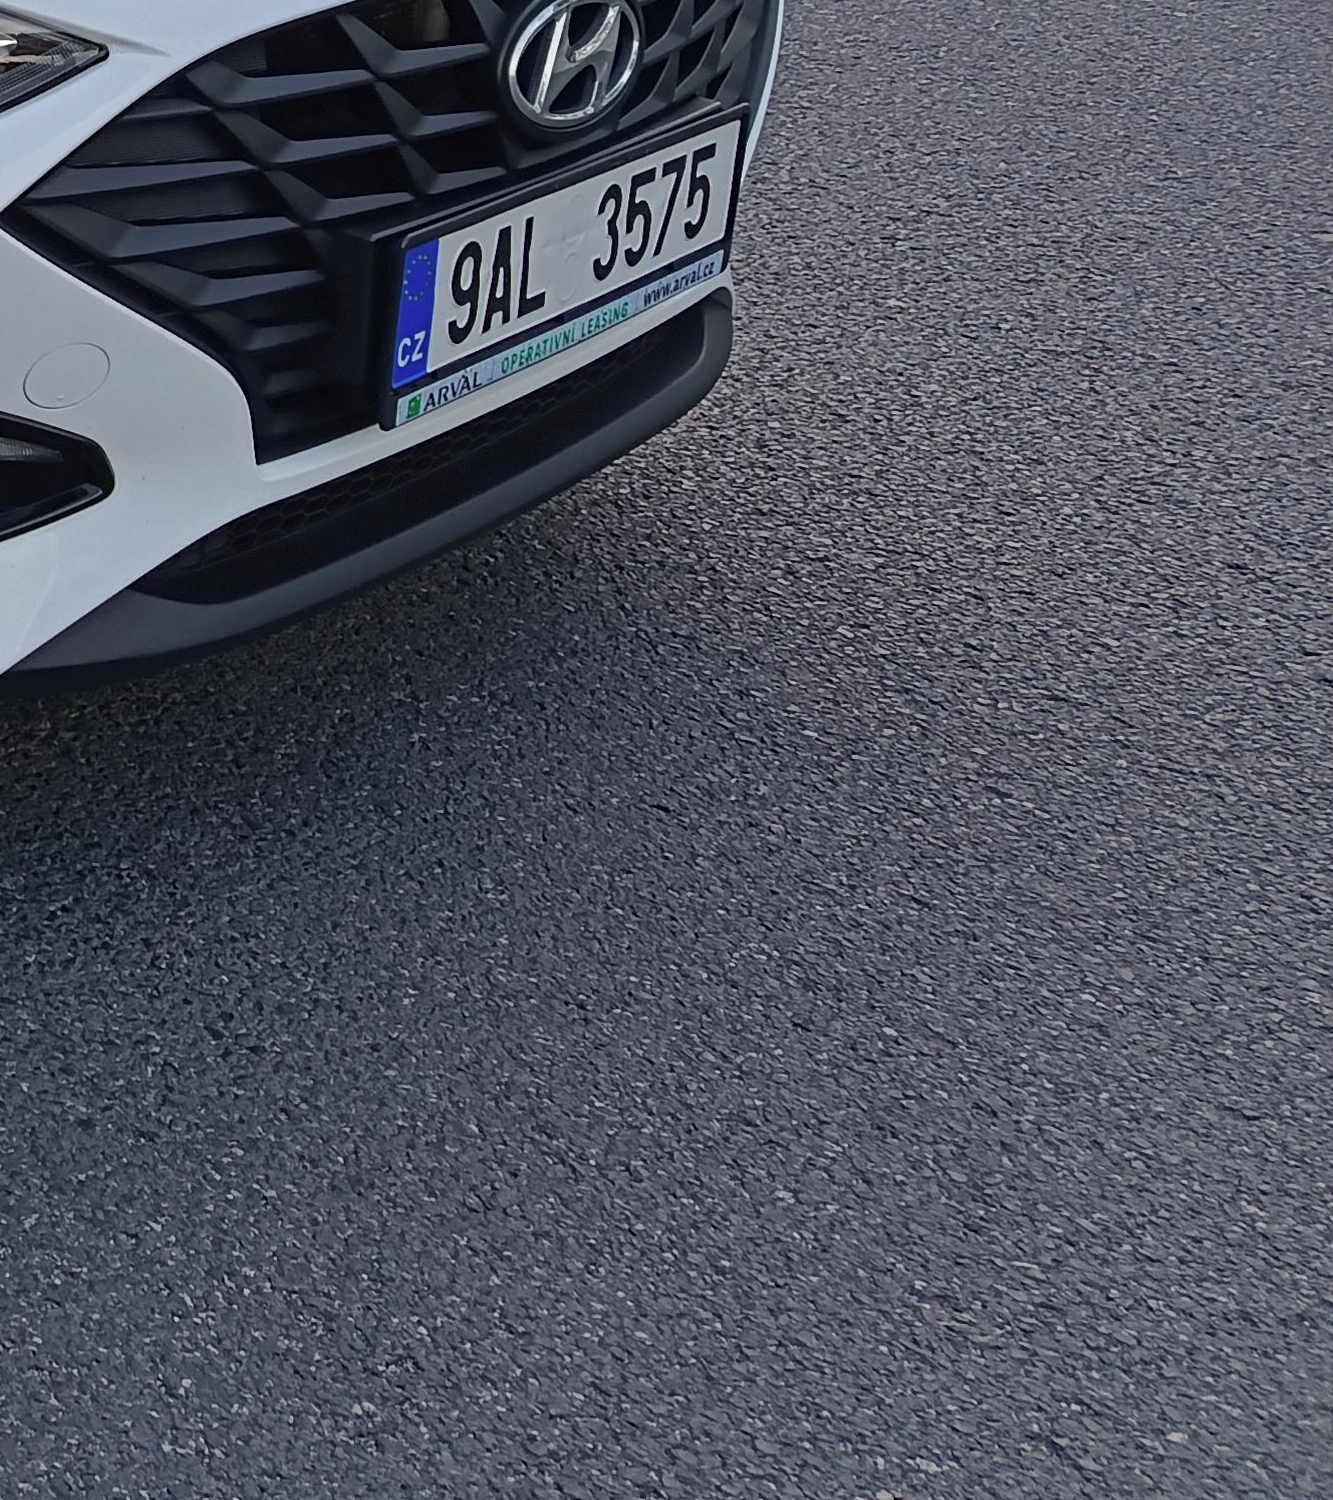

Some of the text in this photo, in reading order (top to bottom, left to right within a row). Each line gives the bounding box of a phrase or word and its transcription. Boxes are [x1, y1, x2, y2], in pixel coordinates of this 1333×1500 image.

[448, 143, 717, 344] 9AL 3575
[397, 331, 425, 367] CZ
[423, 260, 716, 411] ARVAL OPERATIVNÍ LEASING www.arval.cz
